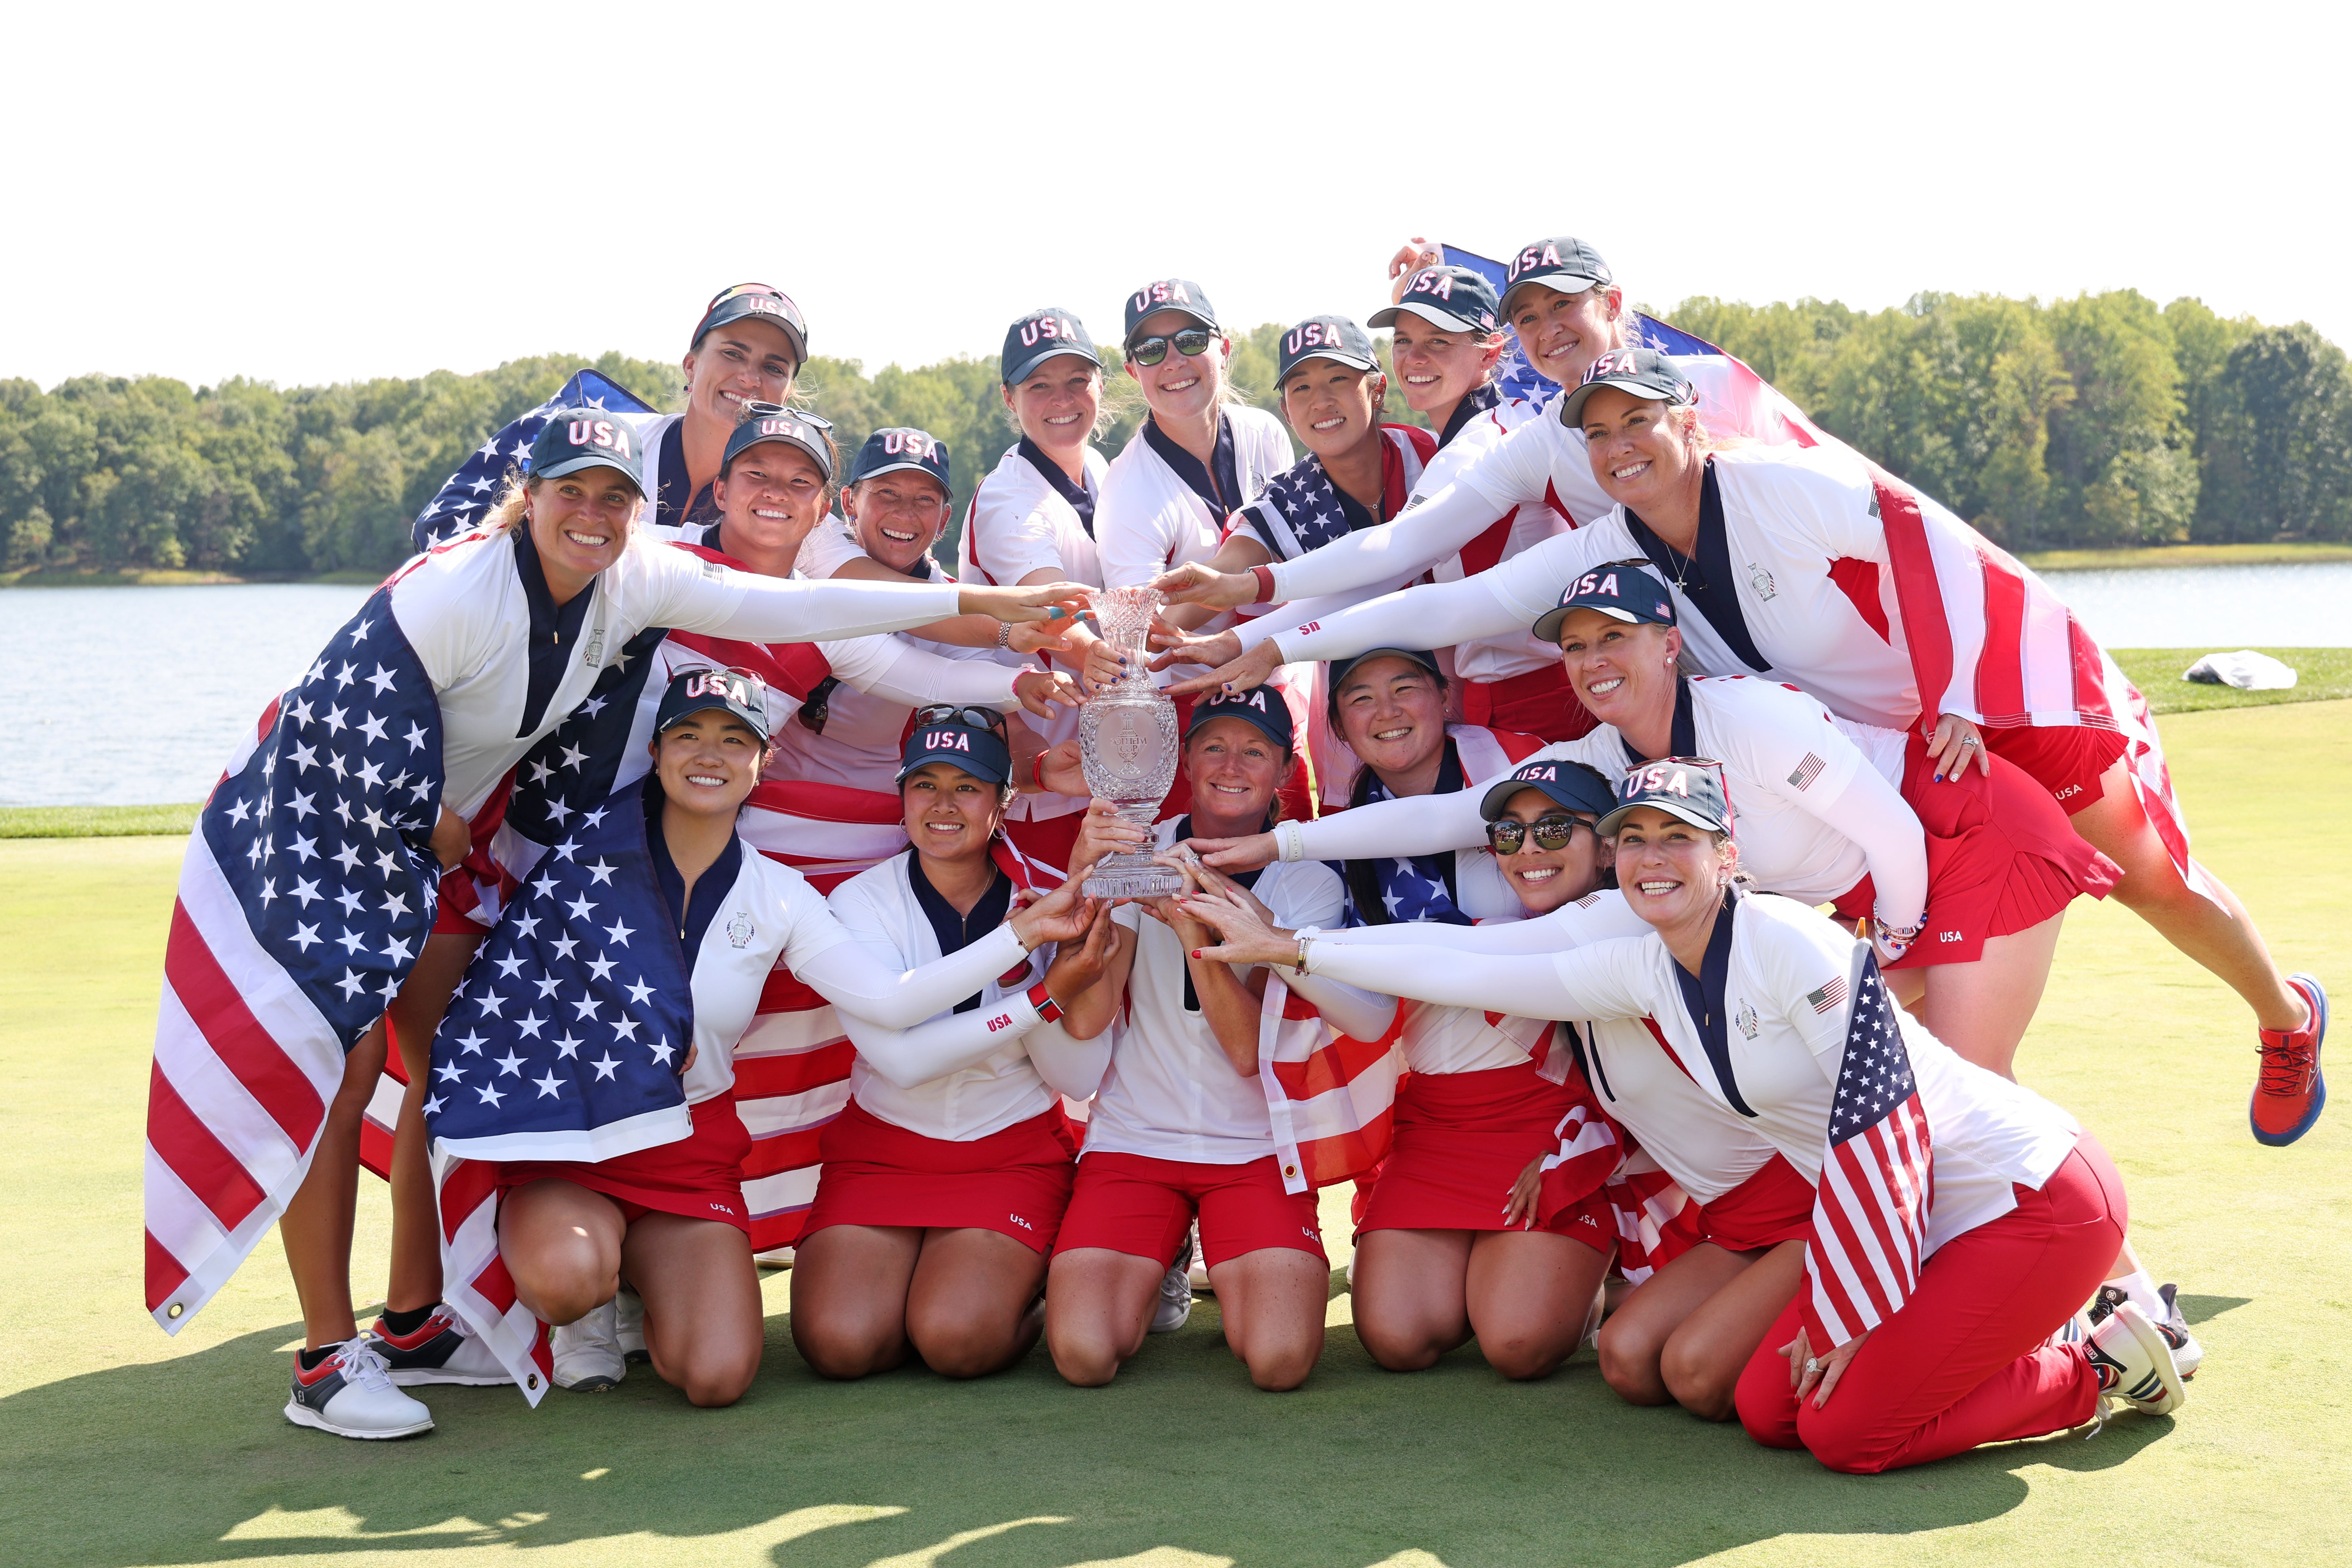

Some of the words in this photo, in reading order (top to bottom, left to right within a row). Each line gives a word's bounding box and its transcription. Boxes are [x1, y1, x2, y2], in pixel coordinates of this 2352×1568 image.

[1508, 245, 1561, 283] USA
[1402, 271, 1453, 301] USA
[749, 297, 788, 319] USA
[1135, 283, 1191, 312] USA
[1020, 317, 1078, 347] USA
[1288, 324, 1343, 355] USA
[1580, 352, 1638, 385] USA
[569, 421, 631, 460] USA
[761, 420, 805, 440] USA
[884, 433, 939, 465] USA
[1562, 573, 1619, 604] USA
[686, 675, 748, 708] USA
[924, 731, 970, 752] USA
[1110, 736, 1147, 745] SOLHEIM
[1516, 766, 1556, 782] USA
[1626, 767, 1689, 799] USA
[2055, 784, 2083, 800] USA
[1940, 931, 1962, 943] USA
[986, 1013, 1013, 1032] USA
[710, 1203, 734, 1216] USA
[1010, 1213, 1033, 1231] USA
[1302, 1227, 1320, 1245] USA
[2084, 1344, 2097, 1359] KITH
